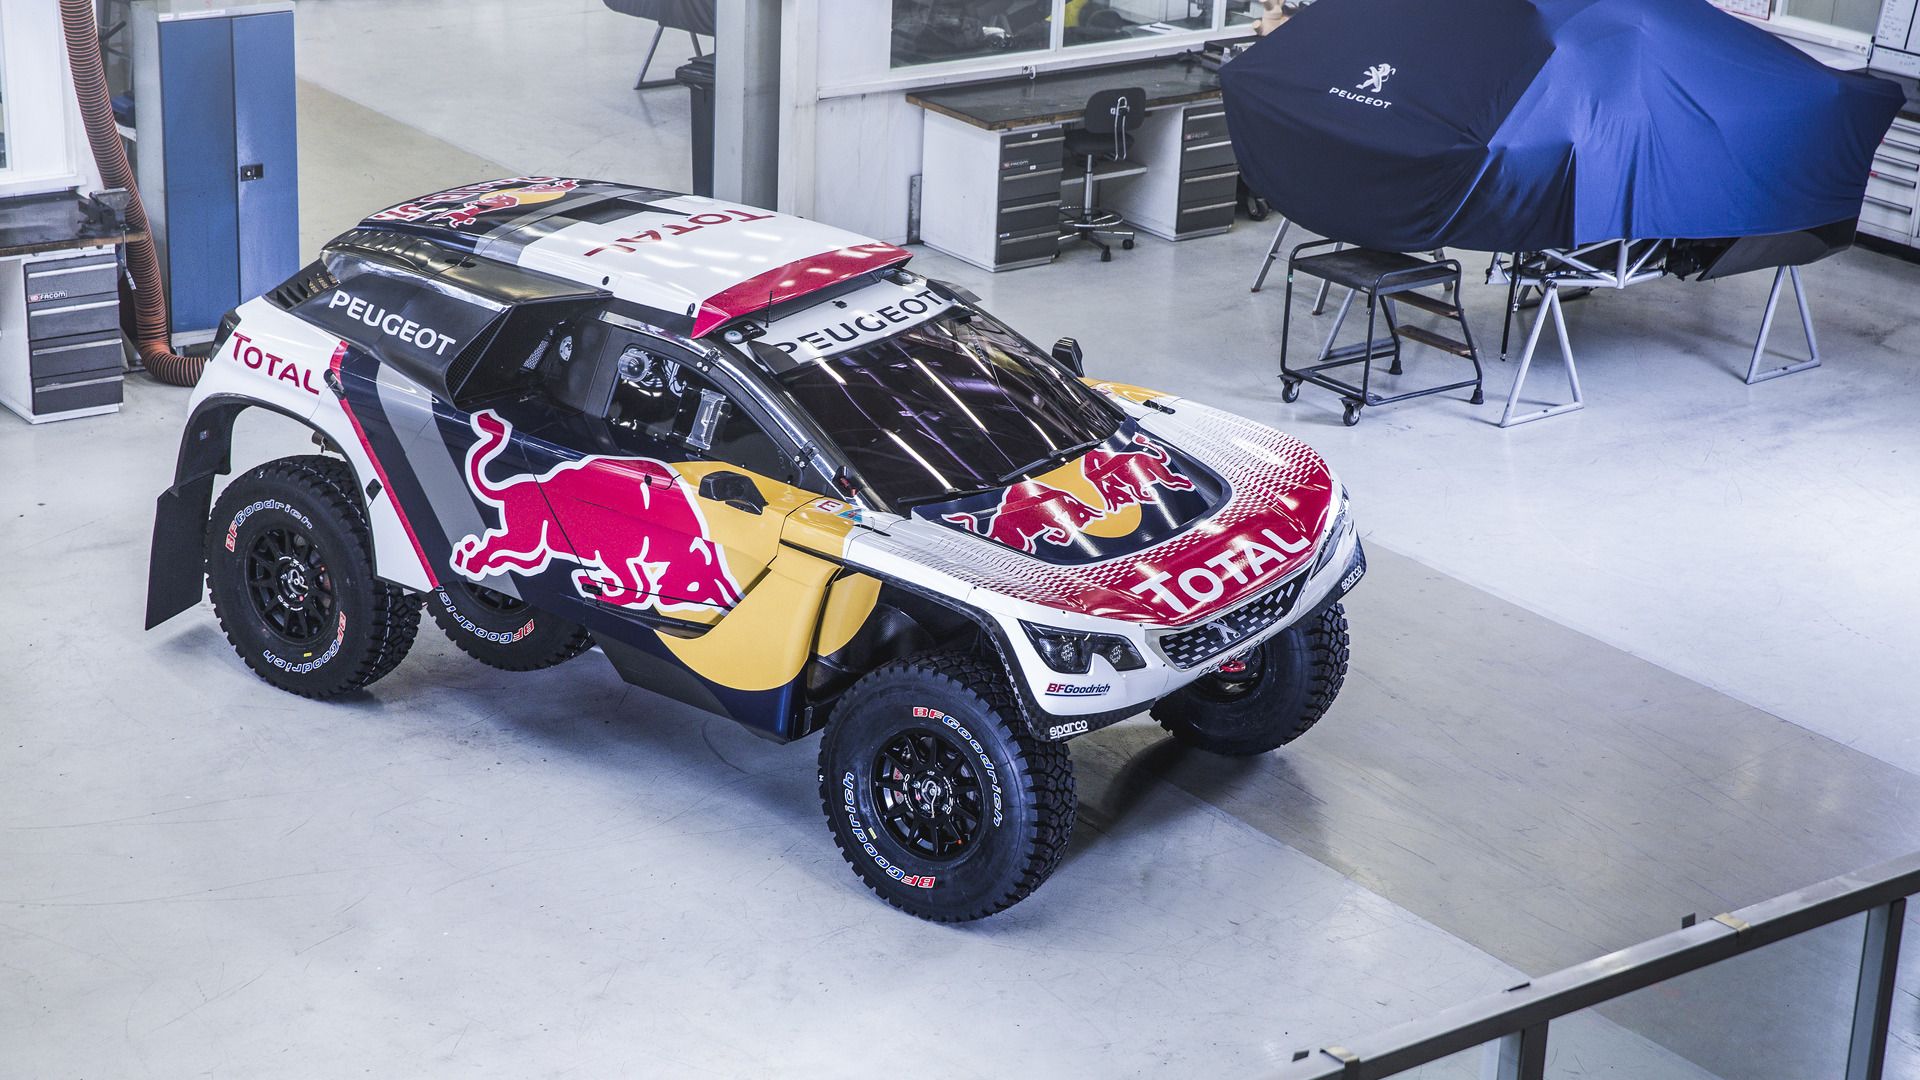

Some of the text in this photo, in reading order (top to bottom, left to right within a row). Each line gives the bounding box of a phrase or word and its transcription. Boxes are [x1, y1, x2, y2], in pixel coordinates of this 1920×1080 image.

[1328, 86, 1392, 109] PEUGEOT
[583, 209, 776, 257] TOTAL
[328, 289, 457, 356] PEUGEOT
[233, 331, 320, 396] TOTAL
[225, 498, 313, 553] BFGoodrich
[1130, 528, 1311, 613] TOTAL
[1341, 565, 1362, 590] sparco
[263, 607, 347, 675] BFGoodrich
[1046, 683, 1110, 694] BFGoodrich
[1049, 720, 1088, 739] sparco
[913, 706, 1003, 827] BFGoodrich
[843, 771, 936, 889] BFGoodrich
